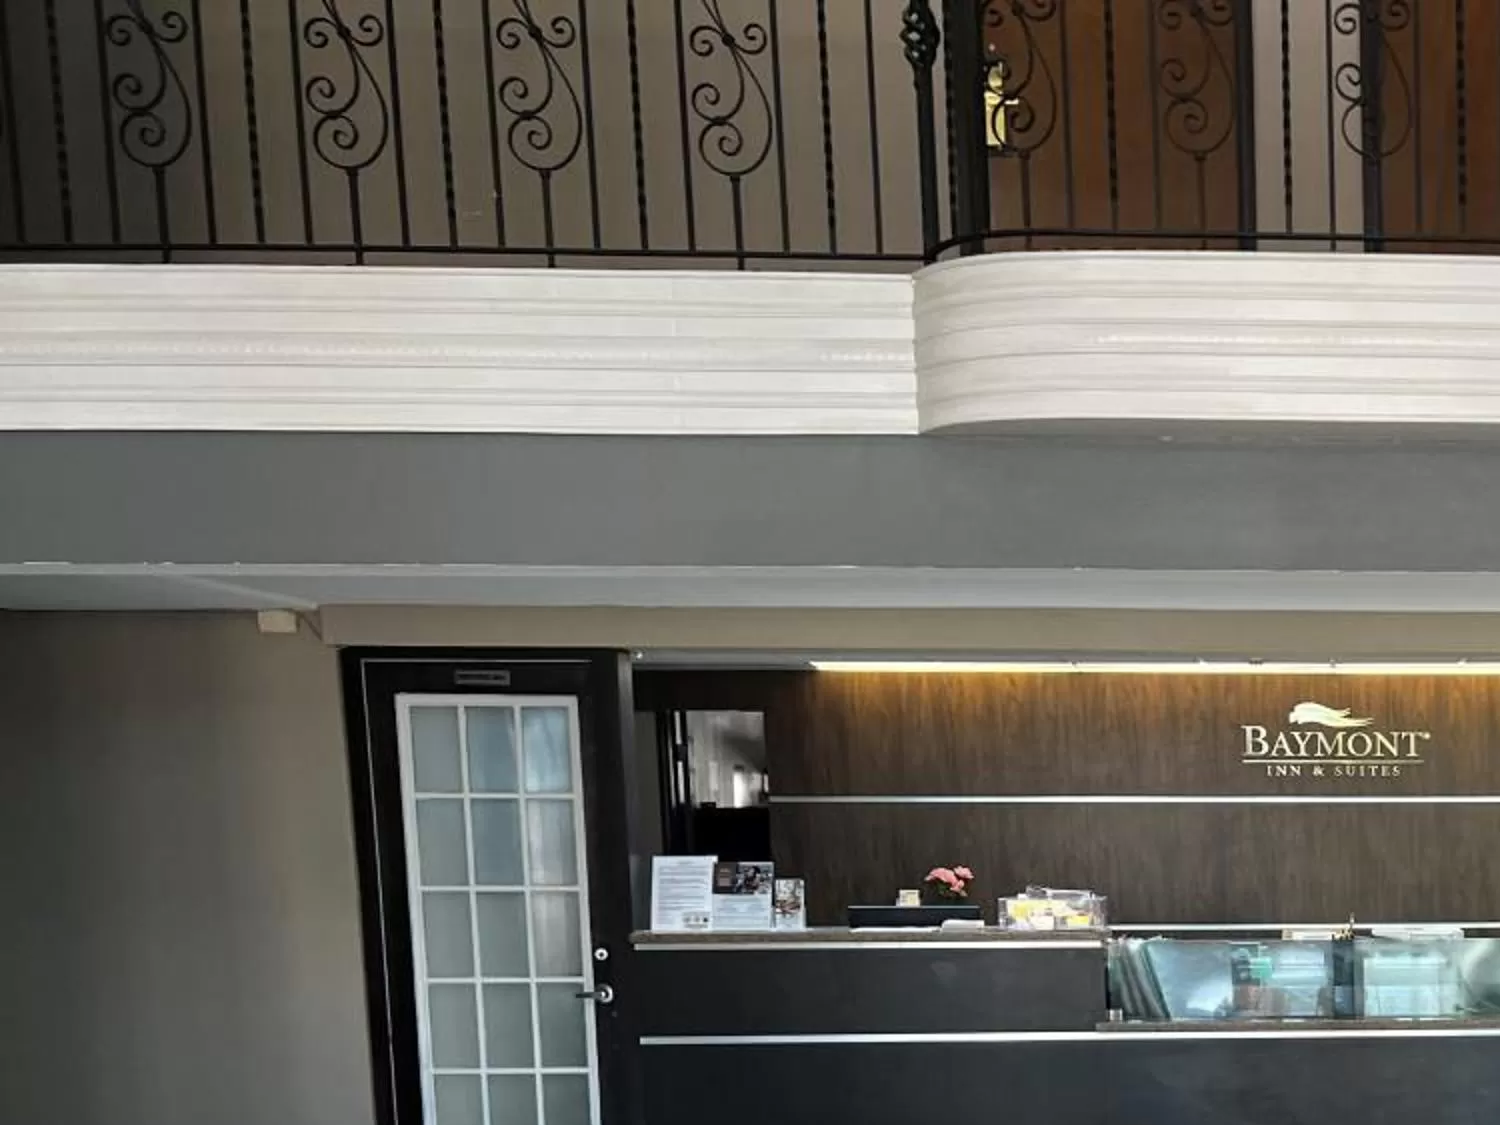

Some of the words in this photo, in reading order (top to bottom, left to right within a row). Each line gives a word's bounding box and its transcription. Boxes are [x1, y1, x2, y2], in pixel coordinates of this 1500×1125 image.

[1241, 725, 1424, 757] BAYMONT
[1266, 765, 1302, 777] INN
[1312, 765, 1325, 777] &
[1333, 765, 1401, 777] SUITES
